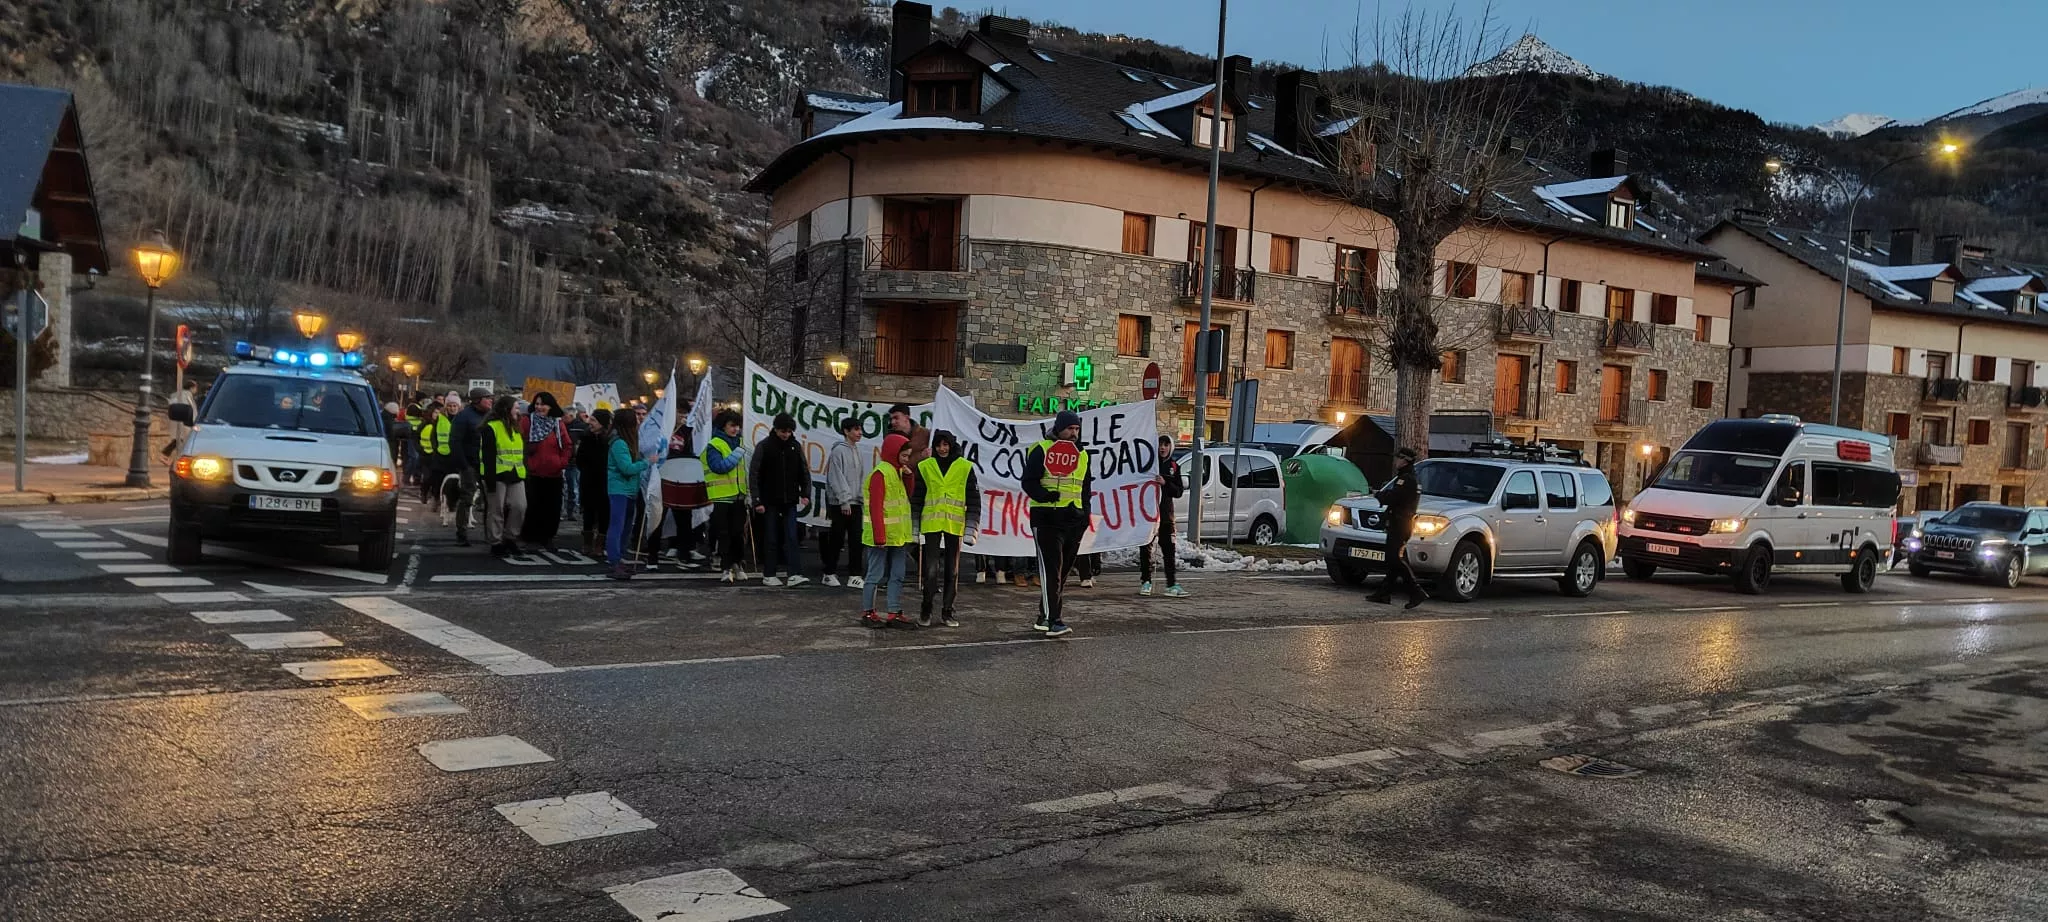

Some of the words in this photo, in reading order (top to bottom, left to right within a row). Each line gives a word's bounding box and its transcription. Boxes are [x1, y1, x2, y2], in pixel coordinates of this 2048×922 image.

[978, 416, 1018, 447] UN
[1047, 451, 1077, 467] STOP
[259, 496, 289, 509] 1284
[295, 499, 319, 511] BYL
